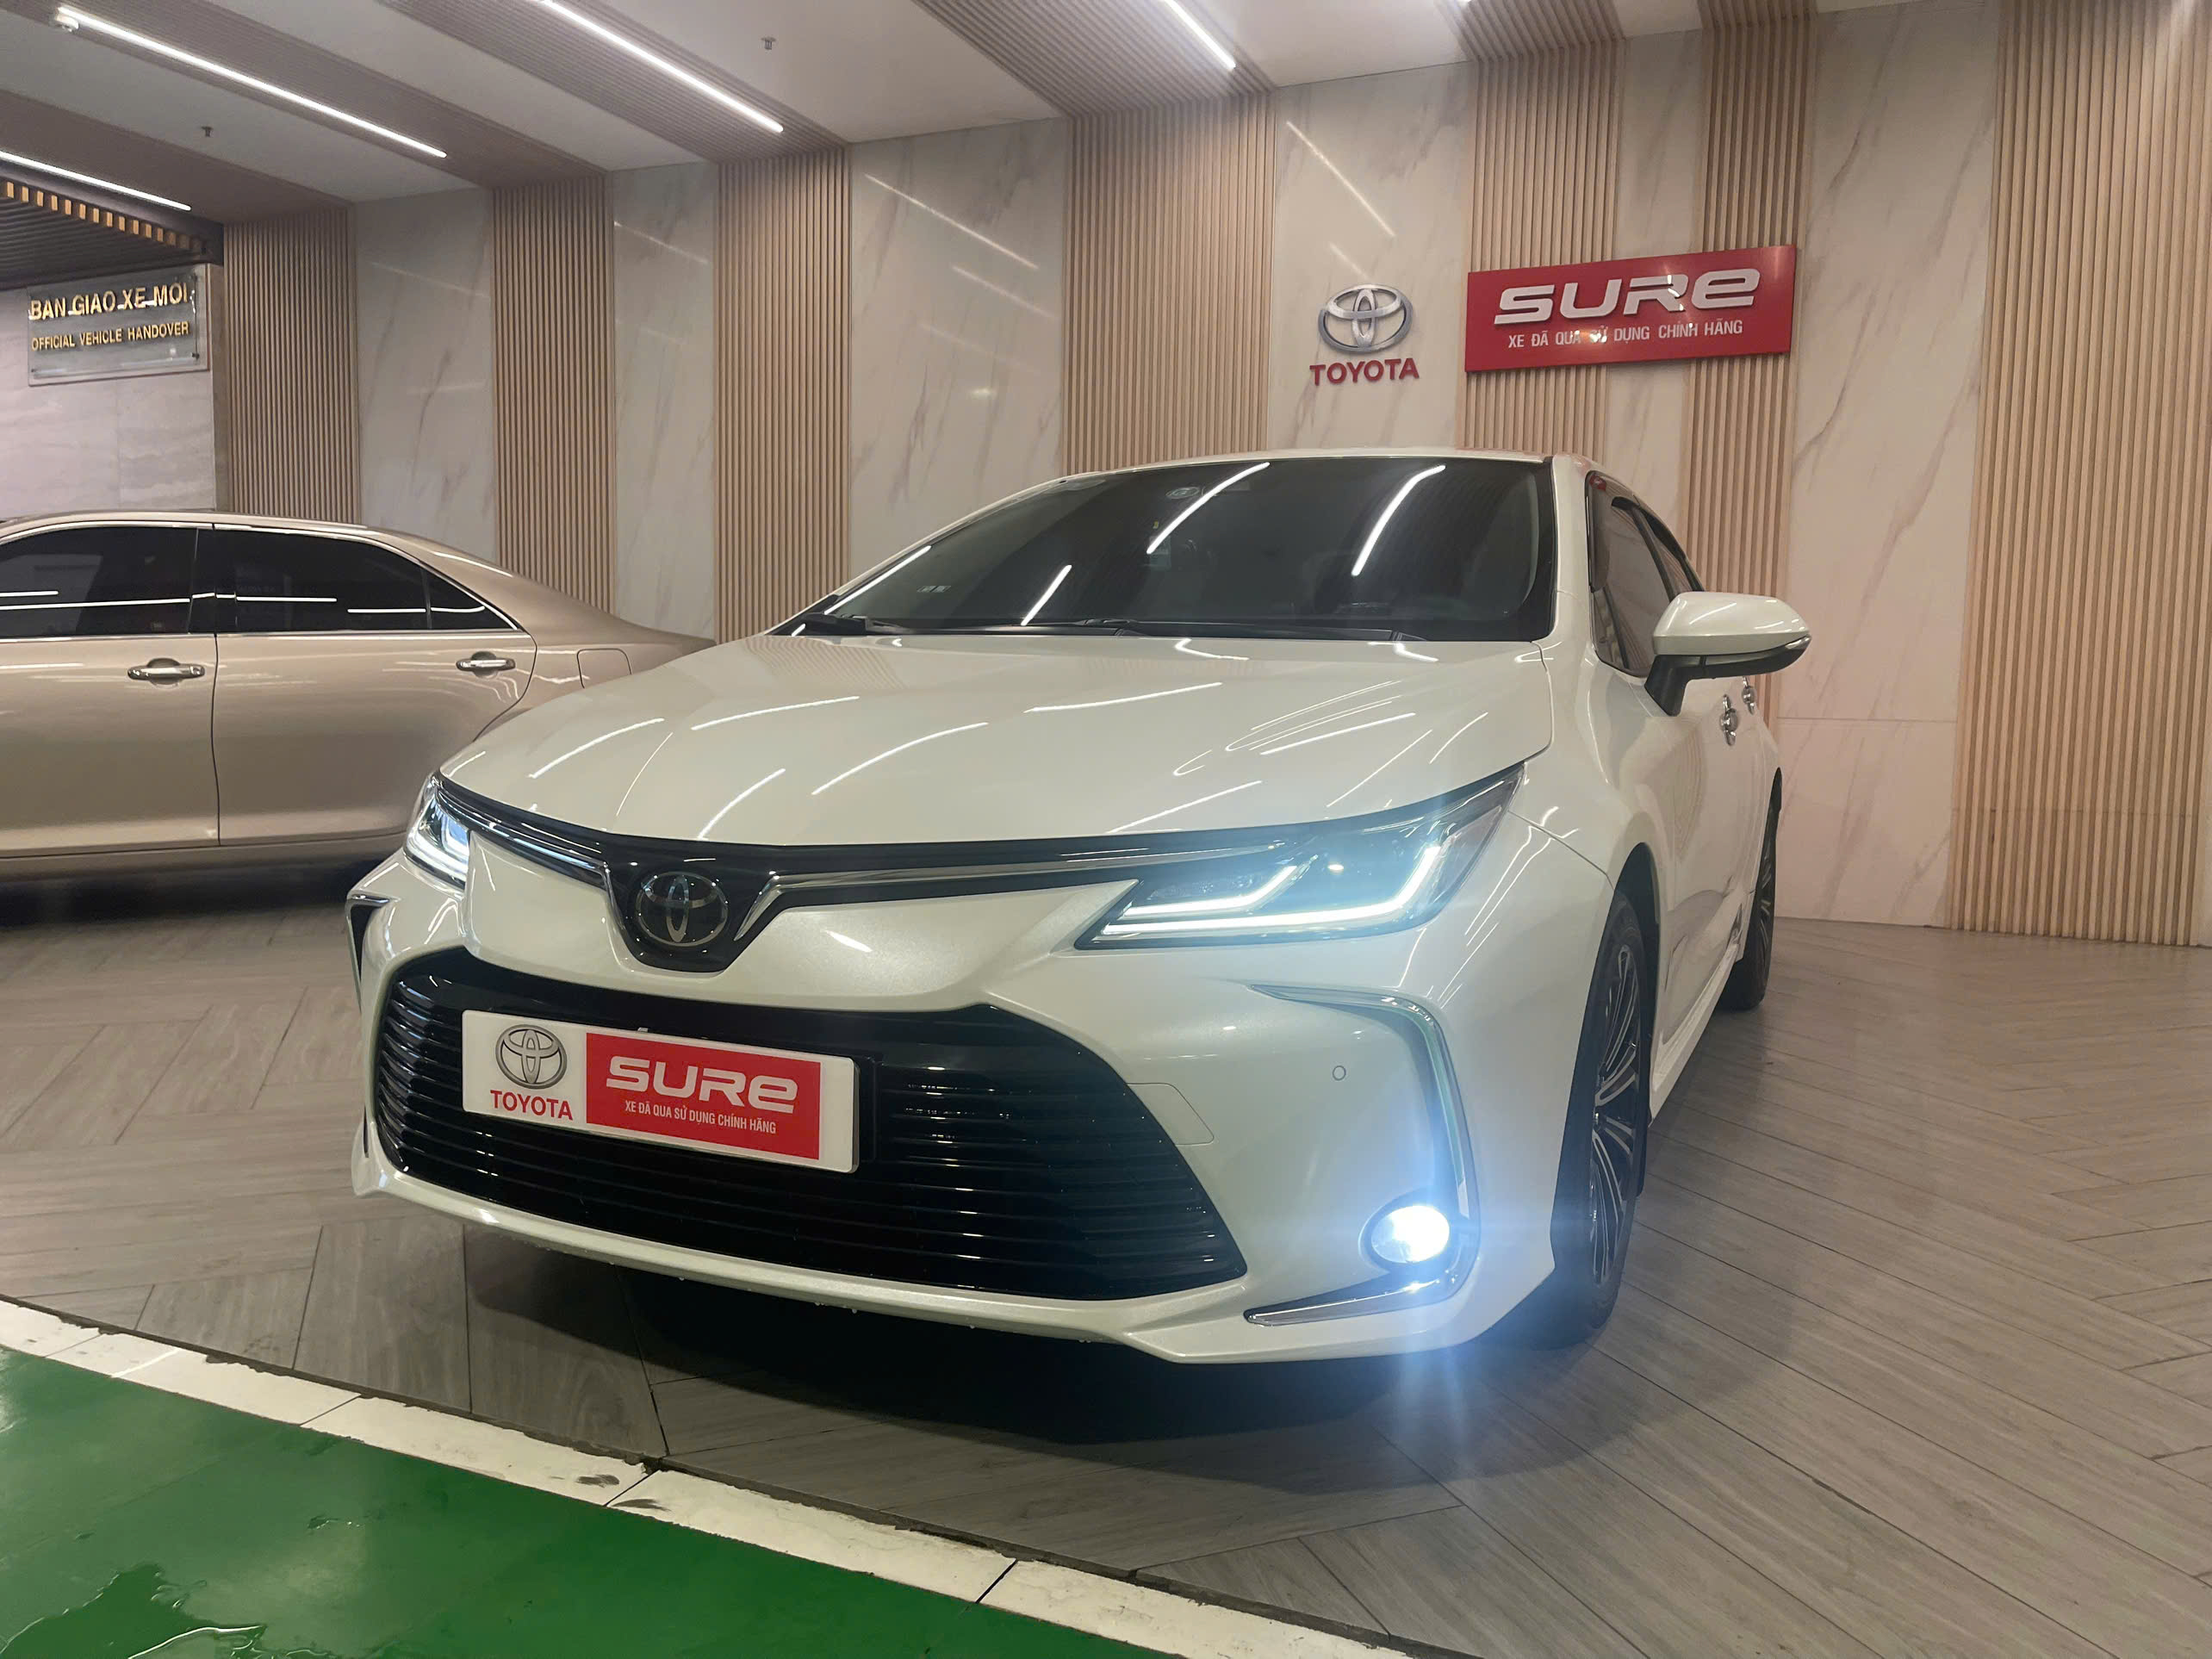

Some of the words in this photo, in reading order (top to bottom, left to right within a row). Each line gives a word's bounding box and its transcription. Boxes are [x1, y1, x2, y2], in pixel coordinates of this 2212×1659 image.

[72, 290, 116, 315] GIAO
[122, 287, 146, 310] XE
[31, 333, 76, 351] OFFICIAL
[80, 328, 122, 346] VEHICLE
[127, 320, 190, 342] HANDOVER
[1508, 334, 1525, 348] XE
[1532, 330, 1549, 346] ĐÃ
[1556, 330, 1581, 345] QUA
[1614, 326, 1650, 345] DỤNG
[1658, 320, 1699, 339] CHÍNH
[1309, 357, 1420, 386] TOYOTA
[490, 1090, 574, 1122] TOYOTA
[624, 1100, 637, 1113] XE
[638, 1101, 651, 1115] ĐÃ
[653, 1105, 672, 1119] QUA
[674, 1105, 687, 1121] SỬ
[689, 1109, 716, 1126] DỤNG
[718, 1113, 747, 1130] CHÍNH
